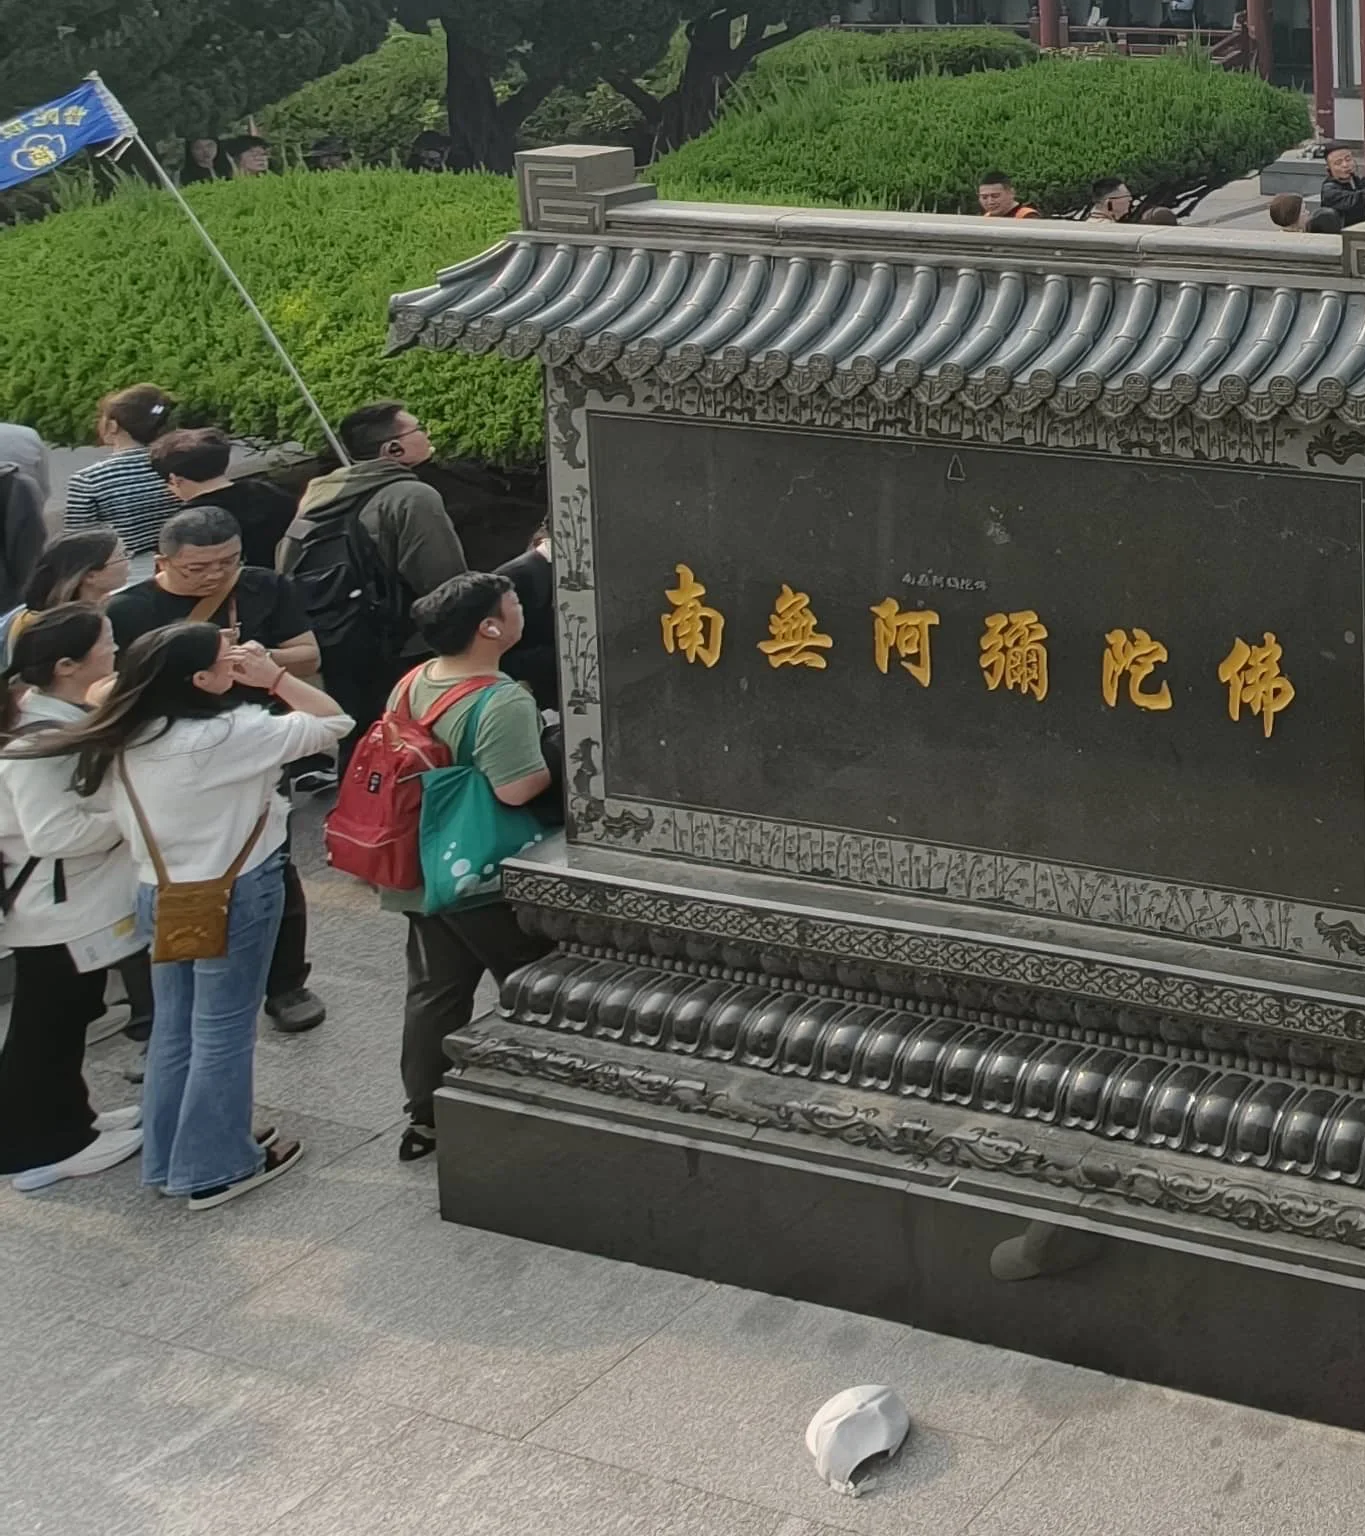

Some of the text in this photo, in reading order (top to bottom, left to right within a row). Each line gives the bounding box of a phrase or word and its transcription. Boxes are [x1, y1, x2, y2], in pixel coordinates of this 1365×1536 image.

[660, 563, 1296, 738] 南無阿彌陀佛
